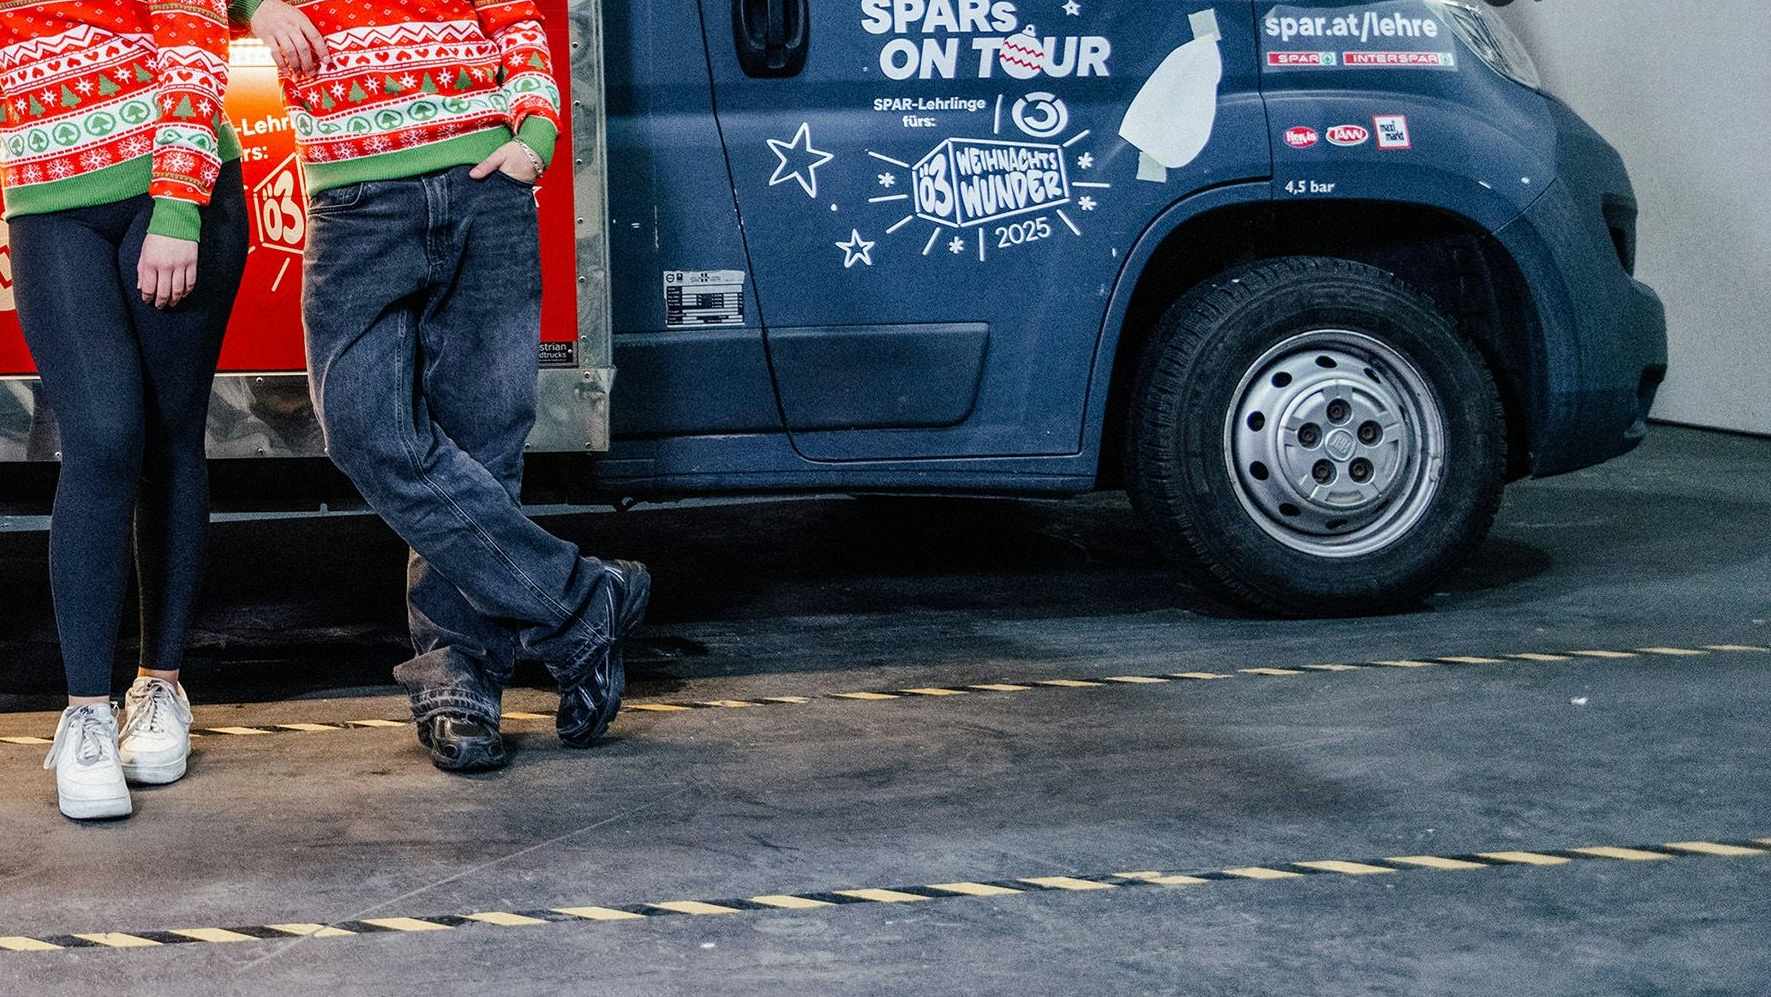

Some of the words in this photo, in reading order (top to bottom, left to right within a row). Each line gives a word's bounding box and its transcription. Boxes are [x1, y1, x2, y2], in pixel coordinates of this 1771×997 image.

[1265, 11, 1438, 43] spar.at/lehre
[879, 37, 959, 81] ON
[1277, 54, 1320, 64] SPAR
[1352, 54, 1439, 65] INTERSPAR
[873, 96, 986, 114] SPAR-Lehrlinge
[902, 115, 936, 128] fürs:
[1334, 129, 1364, 141] TANN
[240, 145, 269, 163] rs:
[956, 146, 1058, 176] WEIHNACHTS
[960, 169, 1064, 218] WUNDER
[1284, 180, 1306, 195] 4,5
[1310, 180, 1335, 193] bar
[995, 216, 1051, 249] 2025
[539, 351, 567, 359] dtrucks
